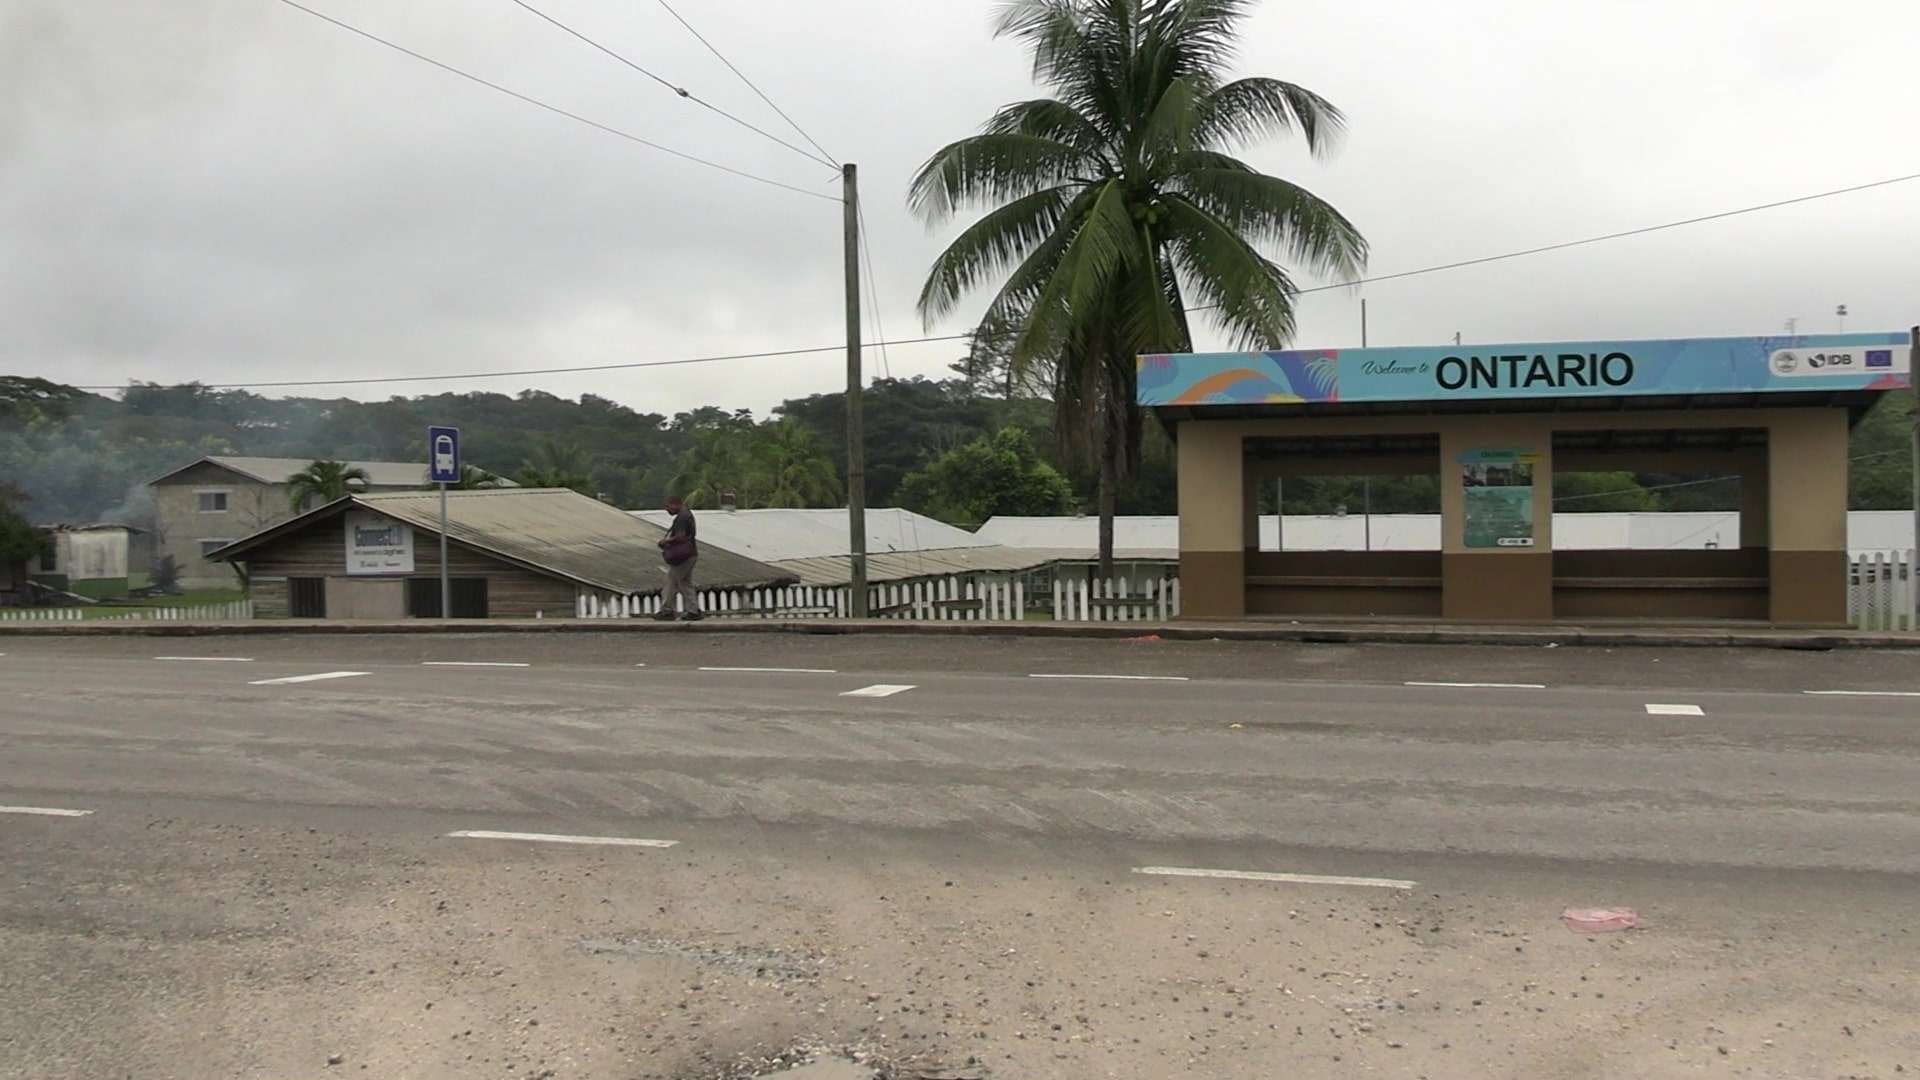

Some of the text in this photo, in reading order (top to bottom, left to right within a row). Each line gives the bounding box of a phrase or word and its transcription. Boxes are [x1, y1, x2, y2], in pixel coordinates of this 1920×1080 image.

[1362, 352, 1634, 390] Welcome to ONTARIO
[1827, 354, 1852, 365] IDB
